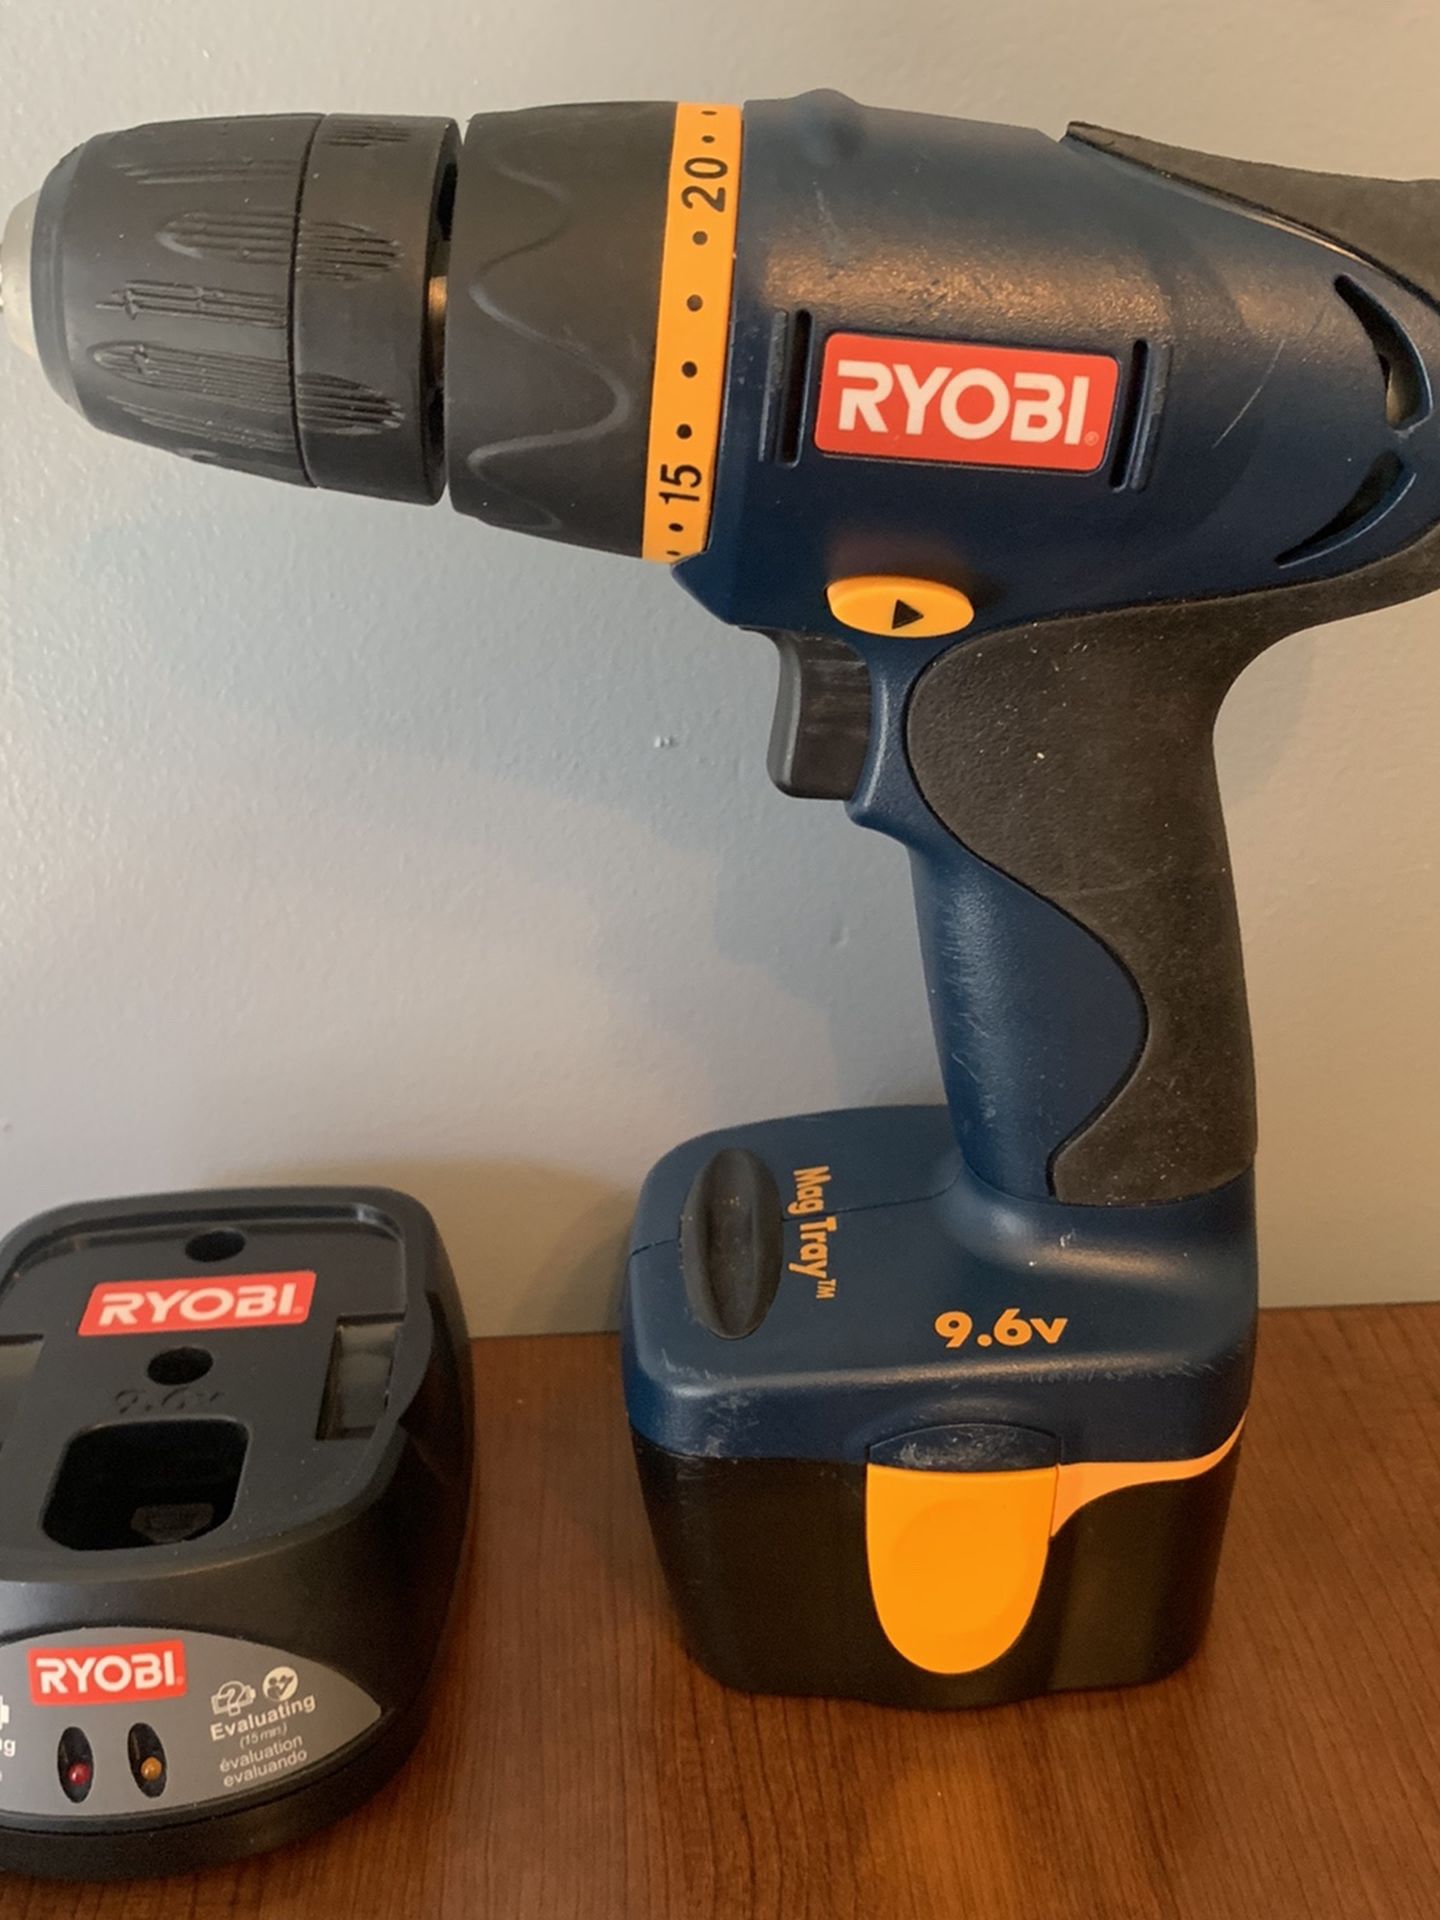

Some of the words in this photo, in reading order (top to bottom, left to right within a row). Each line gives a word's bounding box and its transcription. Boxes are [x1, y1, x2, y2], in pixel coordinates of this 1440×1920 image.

[681, 156, 729, 212] 20
[658, 463, 703, 504] 15
[787, 1165, 832, 1215] Mag
[98, 1283, 297, 1327] RYOBI
[933, 1308, 1069, 1348] 9.6v
[36, 1650, 174, 1694] RYOBI
[210, 1694, 316, 1742] Evaluating
[220, 1735, 304, 1773] évaluation
[223, 1750, 308, 1788] evaluando
